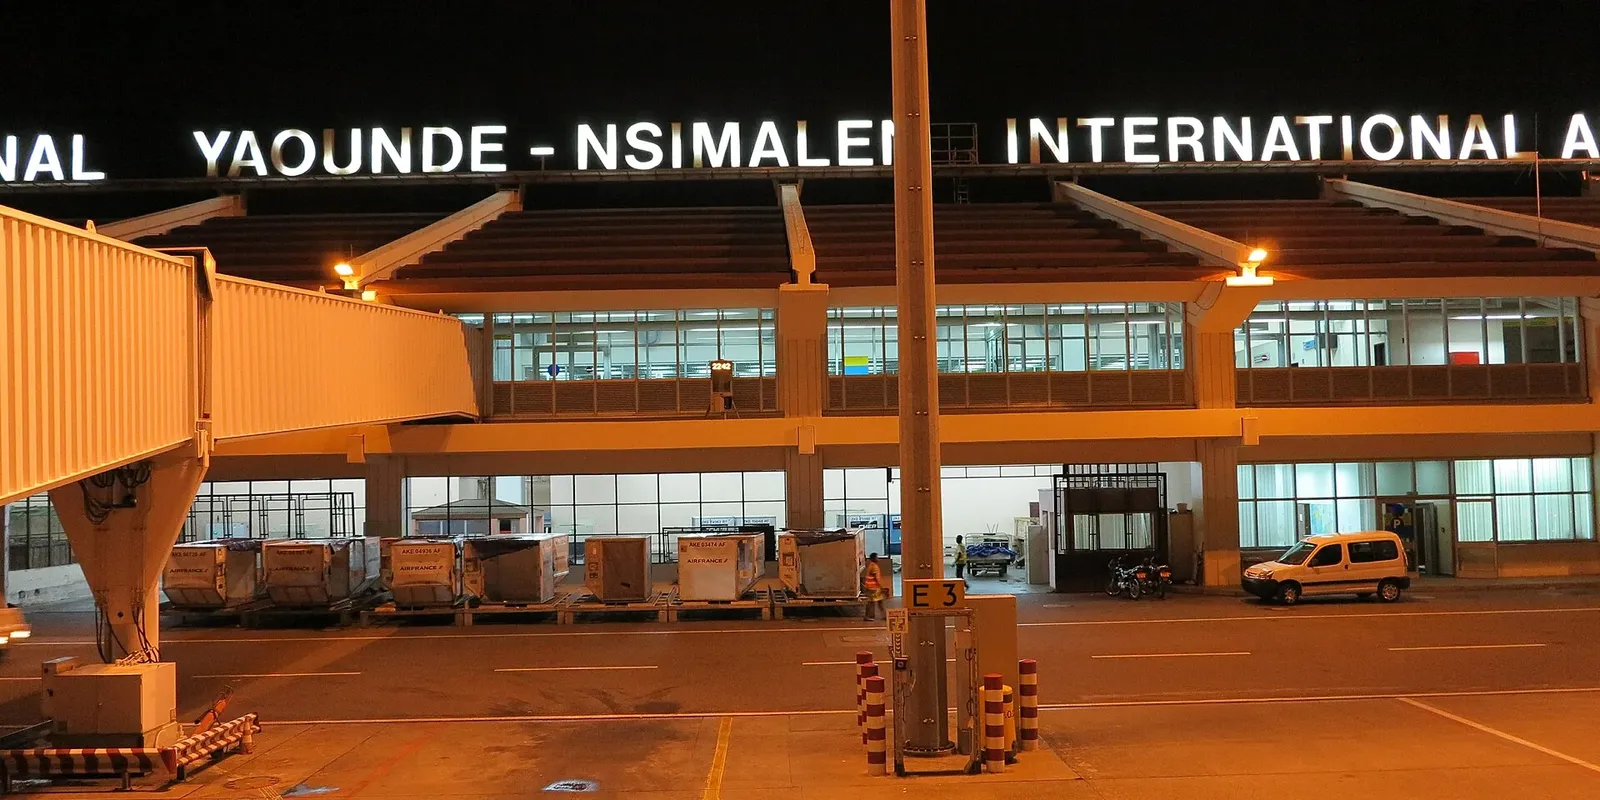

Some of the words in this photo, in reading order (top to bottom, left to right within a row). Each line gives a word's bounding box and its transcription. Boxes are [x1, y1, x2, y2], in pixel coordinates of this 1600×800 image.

[193, 125, 507, 177] YAOUNDE
[1007, 113, 1537, 164] INTERNATIONAL
[711, 362, 732, 370] 2242
[912, 584, 929, 607] E
[943, 583, 957, 606] 3
